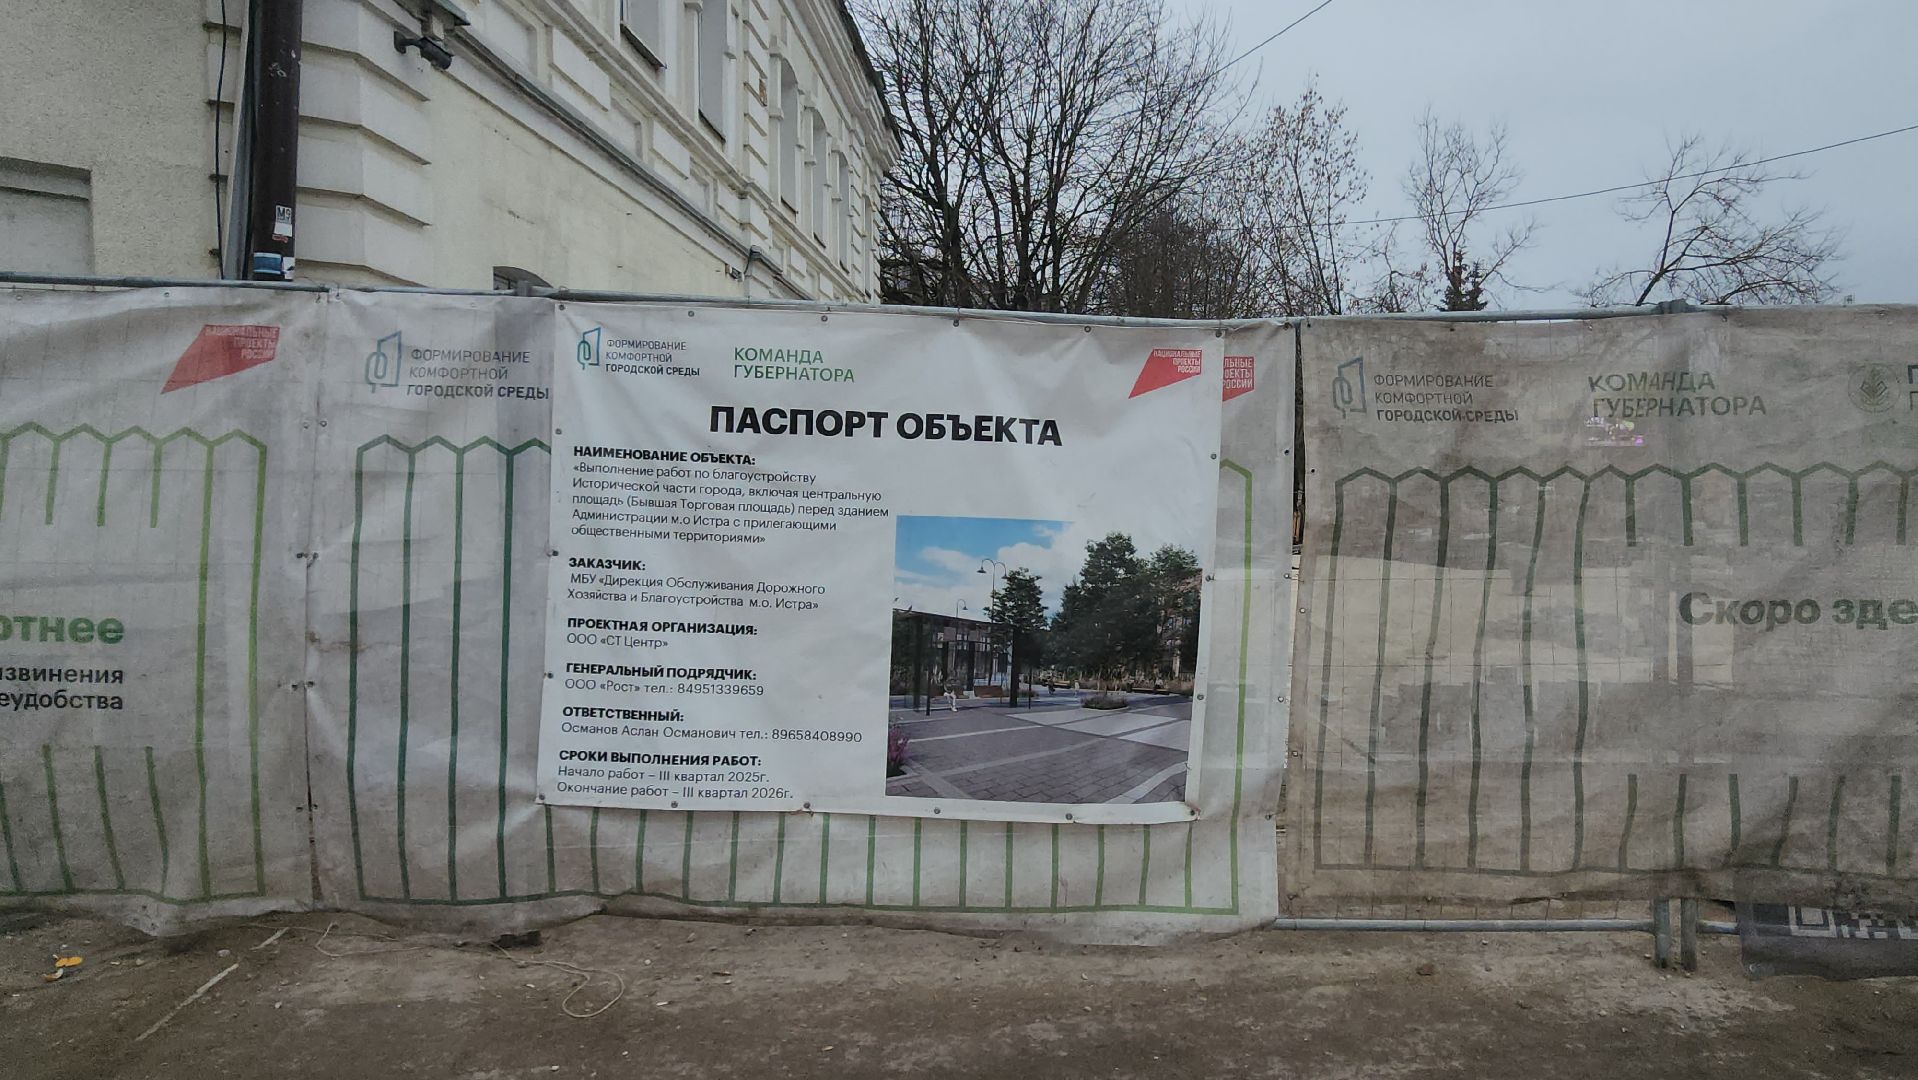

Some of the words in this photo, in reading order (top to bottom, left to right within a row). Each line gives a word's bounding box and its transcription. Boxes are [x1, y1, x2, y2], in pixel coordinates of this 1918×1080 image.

[606, 339, 686, 351] ФОРМИРОВАНИЕ
[411, 349, 531, 363] ФОРМИРОВАНИЕ
[605, 352, 672, 362] КОМФОРТНОЙ
[735, 347, 823, 364] КОМАНДА
[409, 367, 508, 380] КОМФОРТНОЙ
[606, 364, 664, 375] ГОРОДСКОЙ
[666, 366, 699, 377] СРЕДЫ
[734, 365, 854, 382] ГУБЕРНАТОРА
[1374, 375, 1493, 388] ФОРМИРОВАНИЕ
[1588, 372, 1715, 392] КОМАНДА
[407, 384, 493, 398] ГОРОДСКОЙ
[498, 386, 548, 400] СРЕДЫ
[1375, 391, 1473, 405] КОМФОРТНОЙ
[1377, 407, 1462, 422] ГОРОДСКОЙ
[1466, 409, 1518, 422] СРЕДЫ
[1593, 395, 1766, 418] ГУБЕРНАТОРА
[710, 406, 888, 438] ПАСПОРТ
[897, 413, 1062, 447] ОБЪЕКТА
[574, 446, 687, 463] НАИМЕНОВАНИЕ
[690, 451, 755, 465] ОБЪЕКТА:
[574, 463, 654, 477] «Выполнение
[656, 468, 691, 480] работ
[694, 468, 710, 477] по
[712, 469, 816, 484] благоустройству
[573, 478, 659, 493] Исторической
[663, 483, 696, 494] части
[700, 486, 745, 497] города,
[749, 488, 798, 499] включая
[802, 491, 881, 502] центральную
[572, 495, 623, 508] площадь
[626, 496, 677, 510] (Бывшая
[680, 499, 735, 513] Торговая
[739, 501, 794, 516] площадь)
[798, 505, 833, 518] перед
[838, 508, 888, 517] зданием
[573, 510, 668, 526] Администрации
[694, 515, 730, 529] Истра
[744, 518, 836, 532] прилегающими
[571, 527, 670, 541] общественными
[673, 531, 765, 544] территориями»
[569, 558, 645, 570] ЗАКАЗЧИК:
[571, 574, 596, 584] МБУ
[599, 575, 663, 589] «Дирекция
[666, 578, 754, 592] Обслуживания
[756, 582, 825, 595] Дорожного
[568, 589, 626, 601] Хозяйства
[641, 592, 743, 608] Благоустройства
[749, 598, 772, 608] м.о.
[776, 598, 818, 610] Истра»
[1679, 591, 1821, 632] Скоро
[568, 618, 648, 632] ПРОЕКТНАЯ
[652, 621, 757, 636] ОРГАНИЗАЦИЯ:
[567, 633, 597, 645] ООО
[0, 667, 124, 684] звинения
[566, 663, 663, 677] ГЕНЕРАЛЬНЫЙ
[666, 668, 756, 682] ПОДРЯДЧИК:
[565, 679, 596, 690] ООО
[600, 680, 640, 692] «Рост»
[644, 685, 673, 693] тел.:
[677, 684, 764, 696] 84951339659
[563, 706, 683, 722] ОТВЕТСТВЕННЫЙ:
[562, 723, 617, 735] Османов
[621, 726, 659, 737] Аслан
[663, 727, 735, 739] Османович
[739, 730, 767, 740] тел.:
[772, 730, 861, 742] 89658408990
[559, 750, 607, 763] СРОКИ
[610, 752, 709, 766] ВЫПОЛНЕНИЯ
[712, 756, 761, 766] РАБОТ:
[558, 767, 604, 778] Начало
[608, 769, 644, 781] работ
[674, 772, 724, 783] квартал
[728, 771, 769, 782] 2025г.
[557, 782, 627, 795] Окончание
[631, 786, 667, 798] работ
[698, 789, 748, 800] квартал
[751, 788, 793, 799] 2026г.
